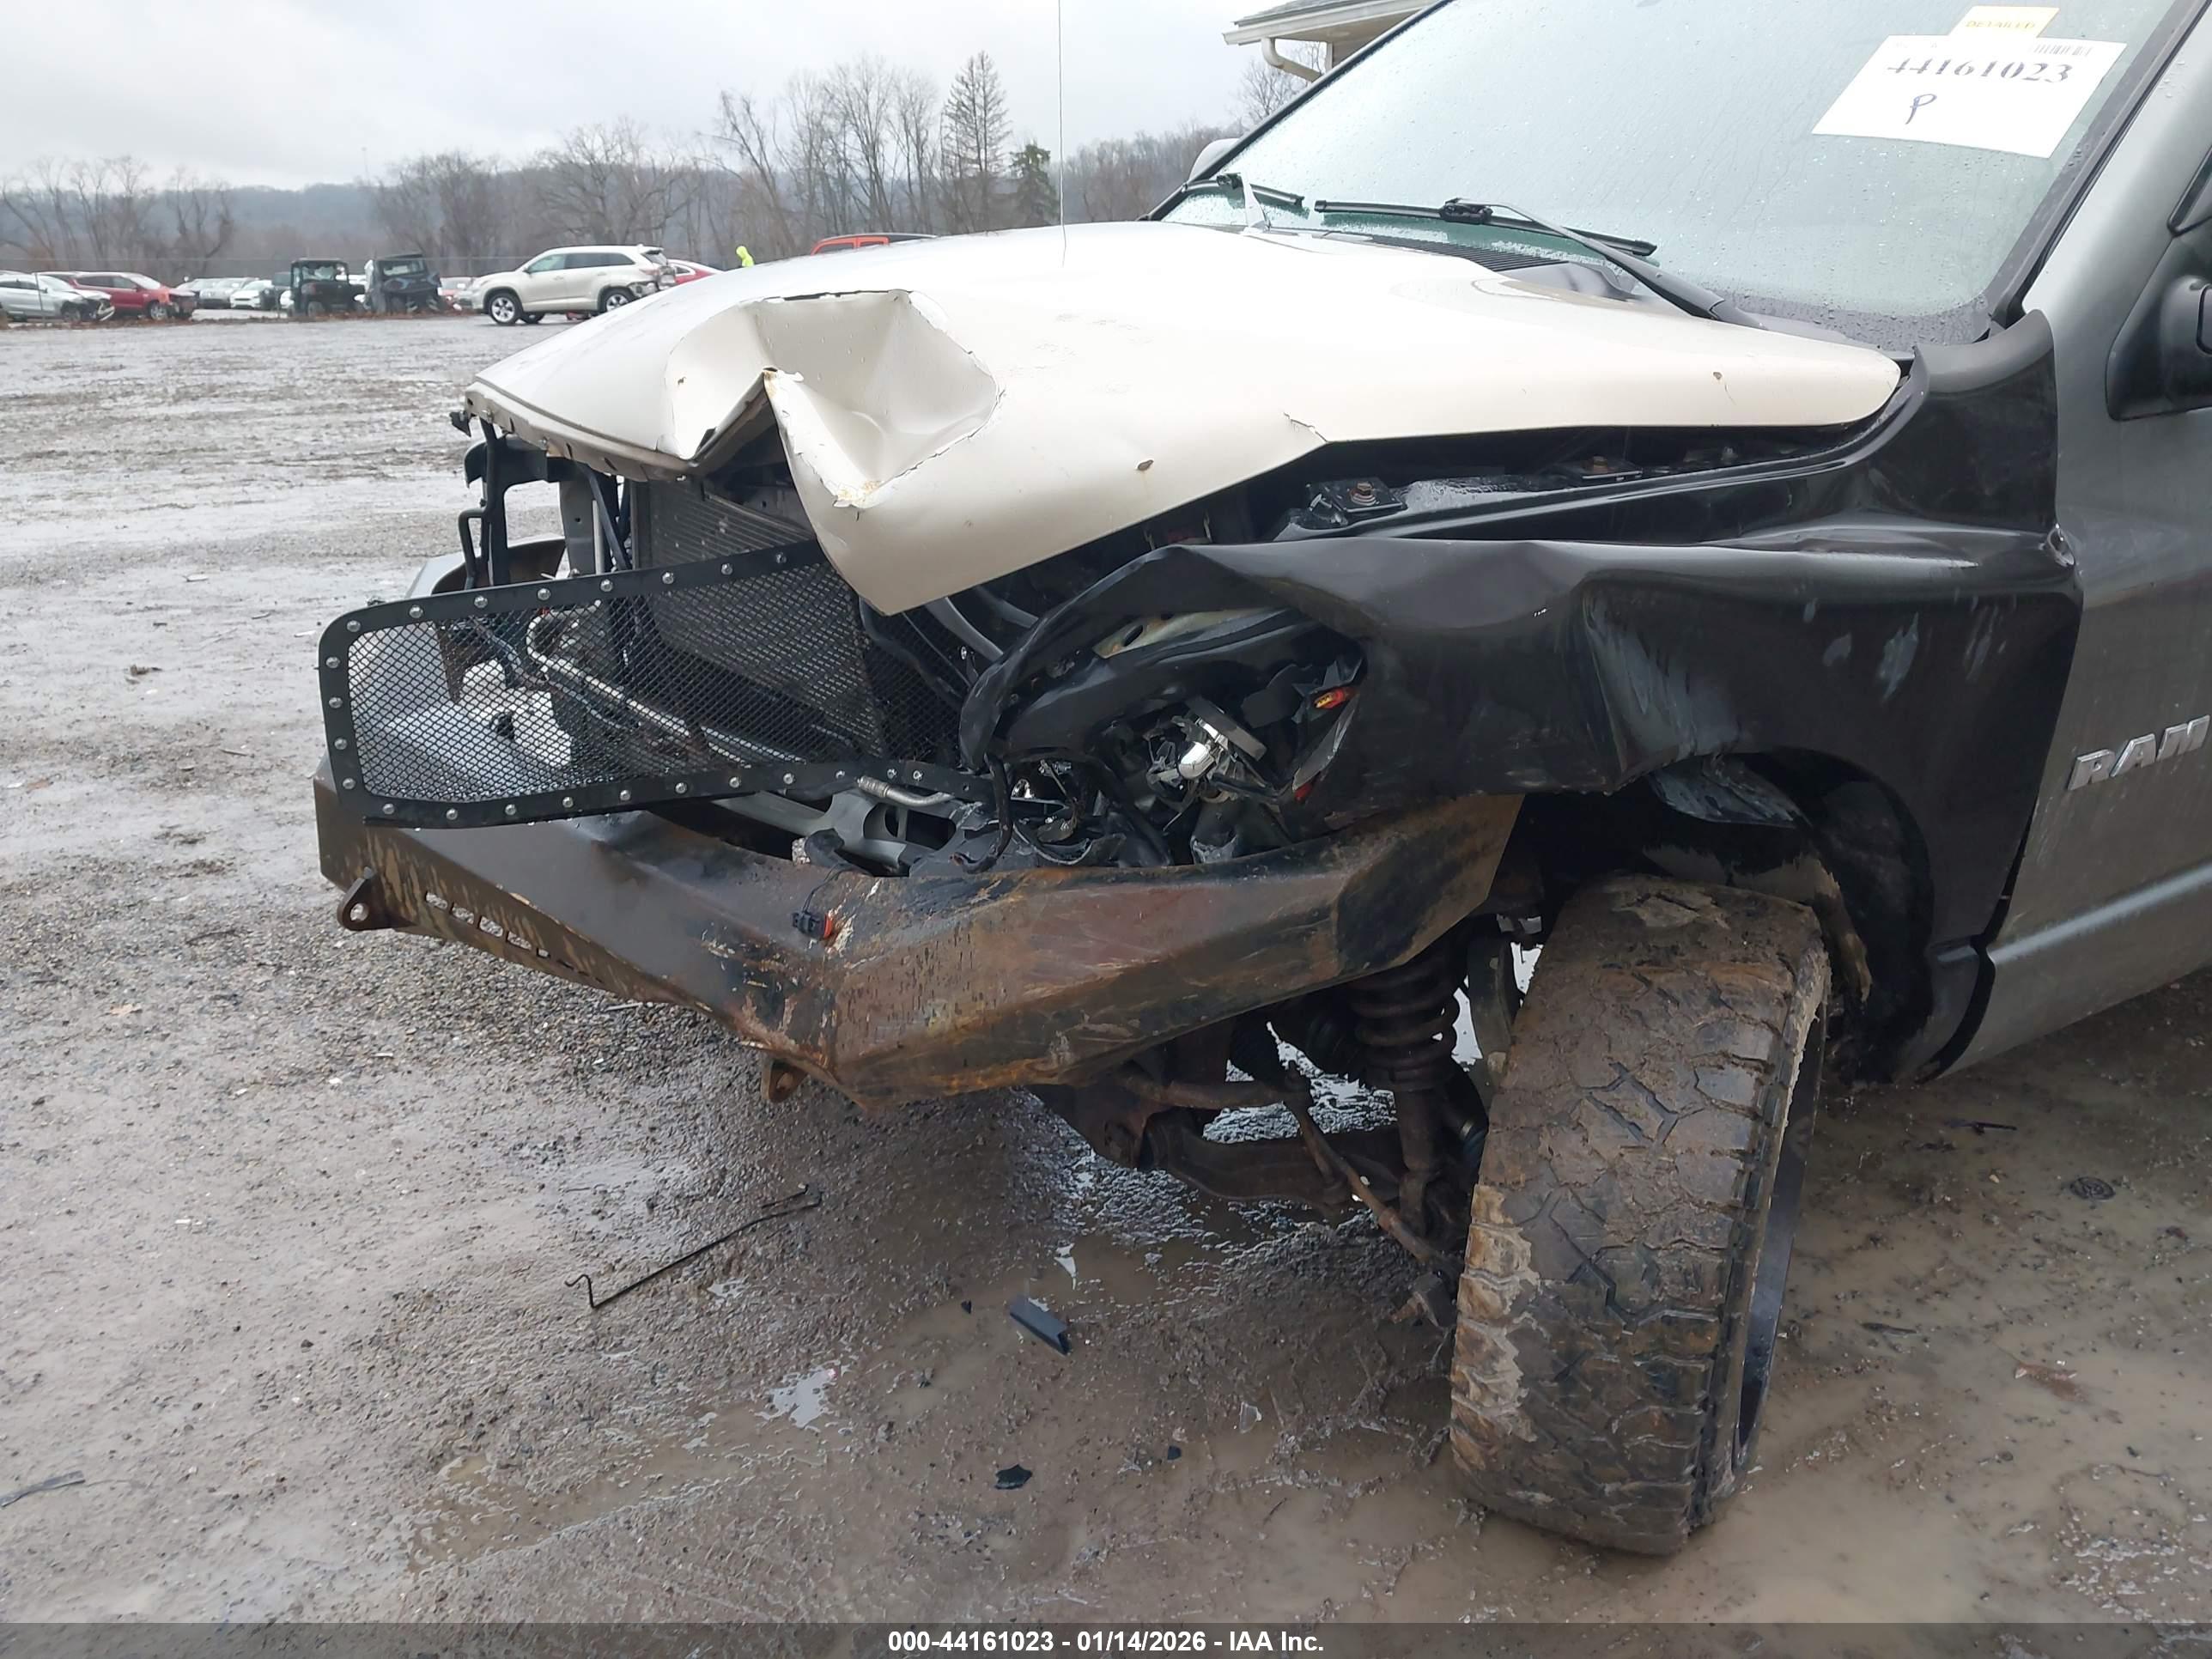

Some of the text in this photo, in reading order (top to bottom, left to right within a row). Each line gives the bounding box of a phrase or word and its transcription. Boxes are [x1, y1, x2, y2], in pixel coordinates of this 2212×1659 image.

[1965, 20, 2036, 29] DETAILED
[1887, 56, 2074, 84] 44161023
[2067, 714, 2211, 791] RAM
